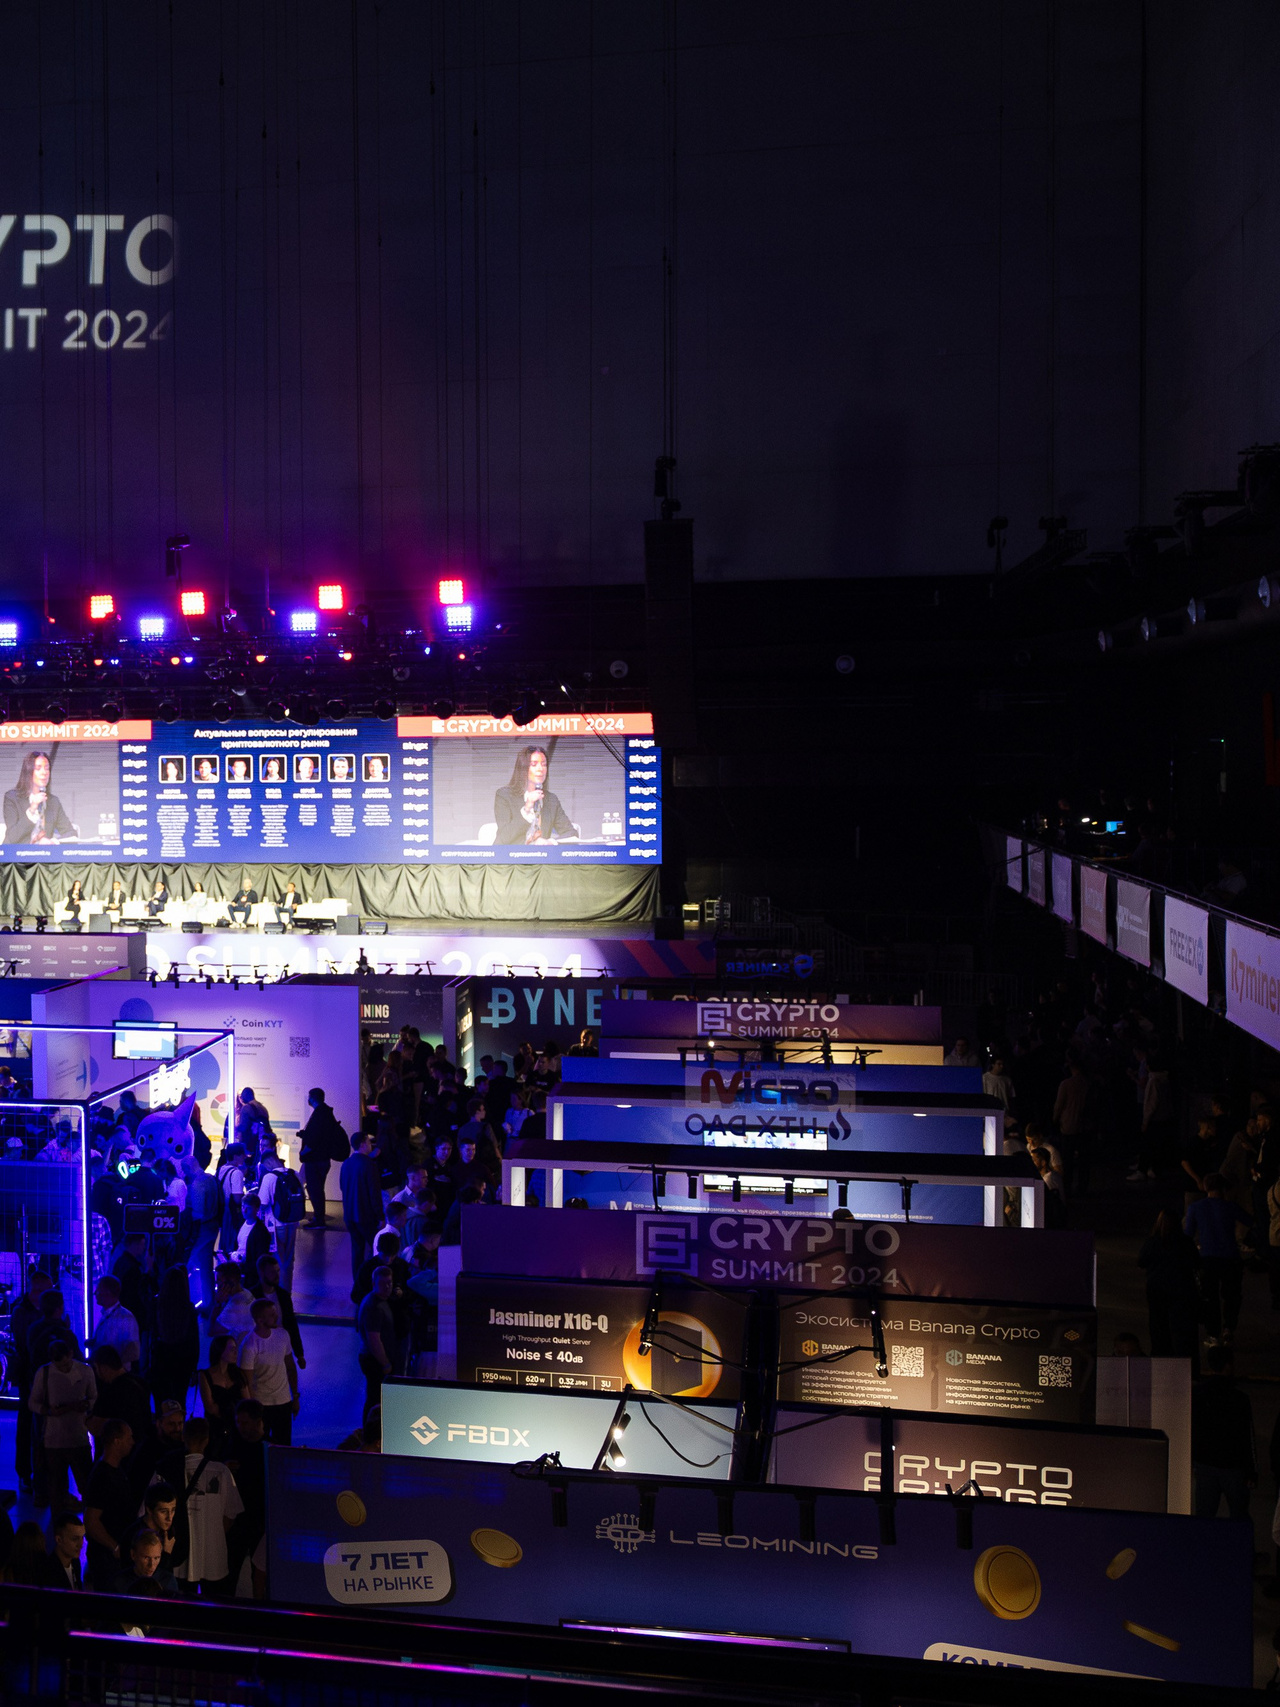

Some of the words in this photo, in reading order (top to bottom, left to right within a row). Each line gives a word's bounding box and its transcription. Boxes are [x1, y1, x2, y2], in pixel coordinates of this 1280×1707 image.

[22, 725, 79, 738] SUMMIT
[83, 724, 118, 737] 2024
[446, 719, 513, 733] CRYPTO
[585, 718, 625, 731] 2024
[361, 1004, 389, 1018] INING
[480, 987, 632, 1029] BYNE
[737, 1004, 840, 1022] CRYPTO
[242, 1020, 283, 1028] CoinKYT
[738, 1026, 798, 1038] SUMMIT
[153, 1216, 175, 1229] 0%
[709, 1217, 900, 1257] CRYPTO
[711, 1258, 822, 1281] SUMMIT
[832, 1264, 900, 1287] 2024
[489, 1308, 562, 1329] Jasminer
[564, 1312, 608, 1333] X16-Q
[909, 1319, 975, 1335] Banana
[981, 1323, 1040, 1340] Crypto
[502, 1334, 516, 1342] High
[518, 1335, 551, 1344] Throughput
[552, 1336, 570, 1344] Quiet
[572, 1338, 590, 1346] Server
[507, 1348, 540, 1360] Noise
[966, 1353, 1002, 1362] BANANA
[482, 1372, 498, 1381] 1950
[802, 1367, 854, 1376] Инвестиционный
[526, 1375, 538, 1383] 620
[559, 1377, 574, 1386] 0.32
[601, 1380, 611, 1388] 3U
[830, 1376, 886, 1385] специализируется
[946, 1377, 981, 1385] Новостная
[811, 1382, 854, 1390] эффективном
[946, 1385, 1004, 1394] предоставляющая
[1006, 1389, 1042, 1397] актуальную
[802, 1395, 843, 1403] собственной
[833, 1390, 866, 1398] используя
[946, 1392, 988, 1400] информацию
[995, 1394, 1019, 1402] свежие
[955, 1400, 1009, 1408] криптовалютном
[448, 1423, 530, 1447] FBOX
[864, 1451, 1073, 1489] CRYPTO
[864, 1476, 1073, 1506] RGE
[670, 1530, 878, 1560] LEOMINING
[341, 1554, 361, 1571] 7
[370, 1551, 429, 1571] ЛЕТ
[343, 1578, 369, 1592] НА
[373, 1576, 434, 1592] РЫНКЕ
